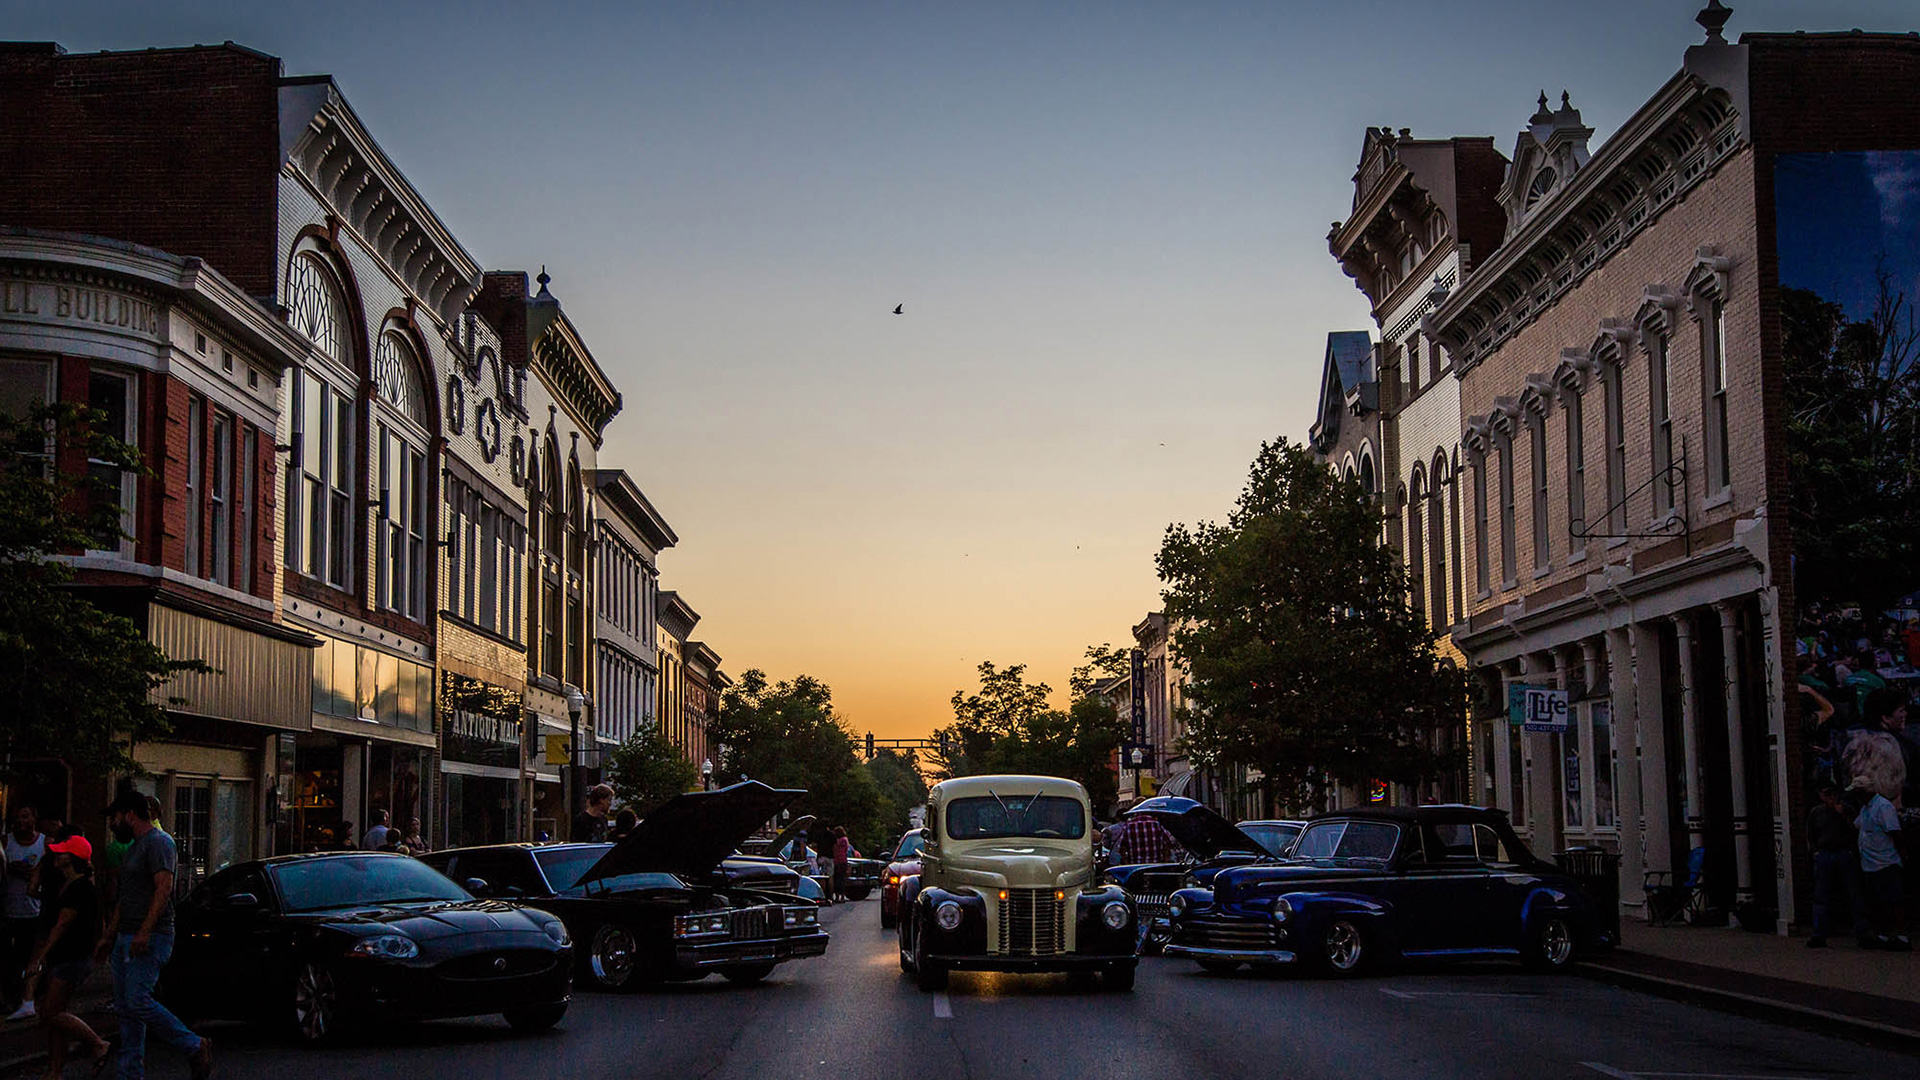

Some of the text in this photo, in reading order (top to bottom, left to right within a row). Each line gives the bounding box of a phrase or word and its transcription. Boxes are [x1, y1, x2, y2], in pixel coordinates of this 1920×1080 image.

[56, 285, 157, 334] BUILDING
[452, 709, 520, 744] ANTIQUE MALL
